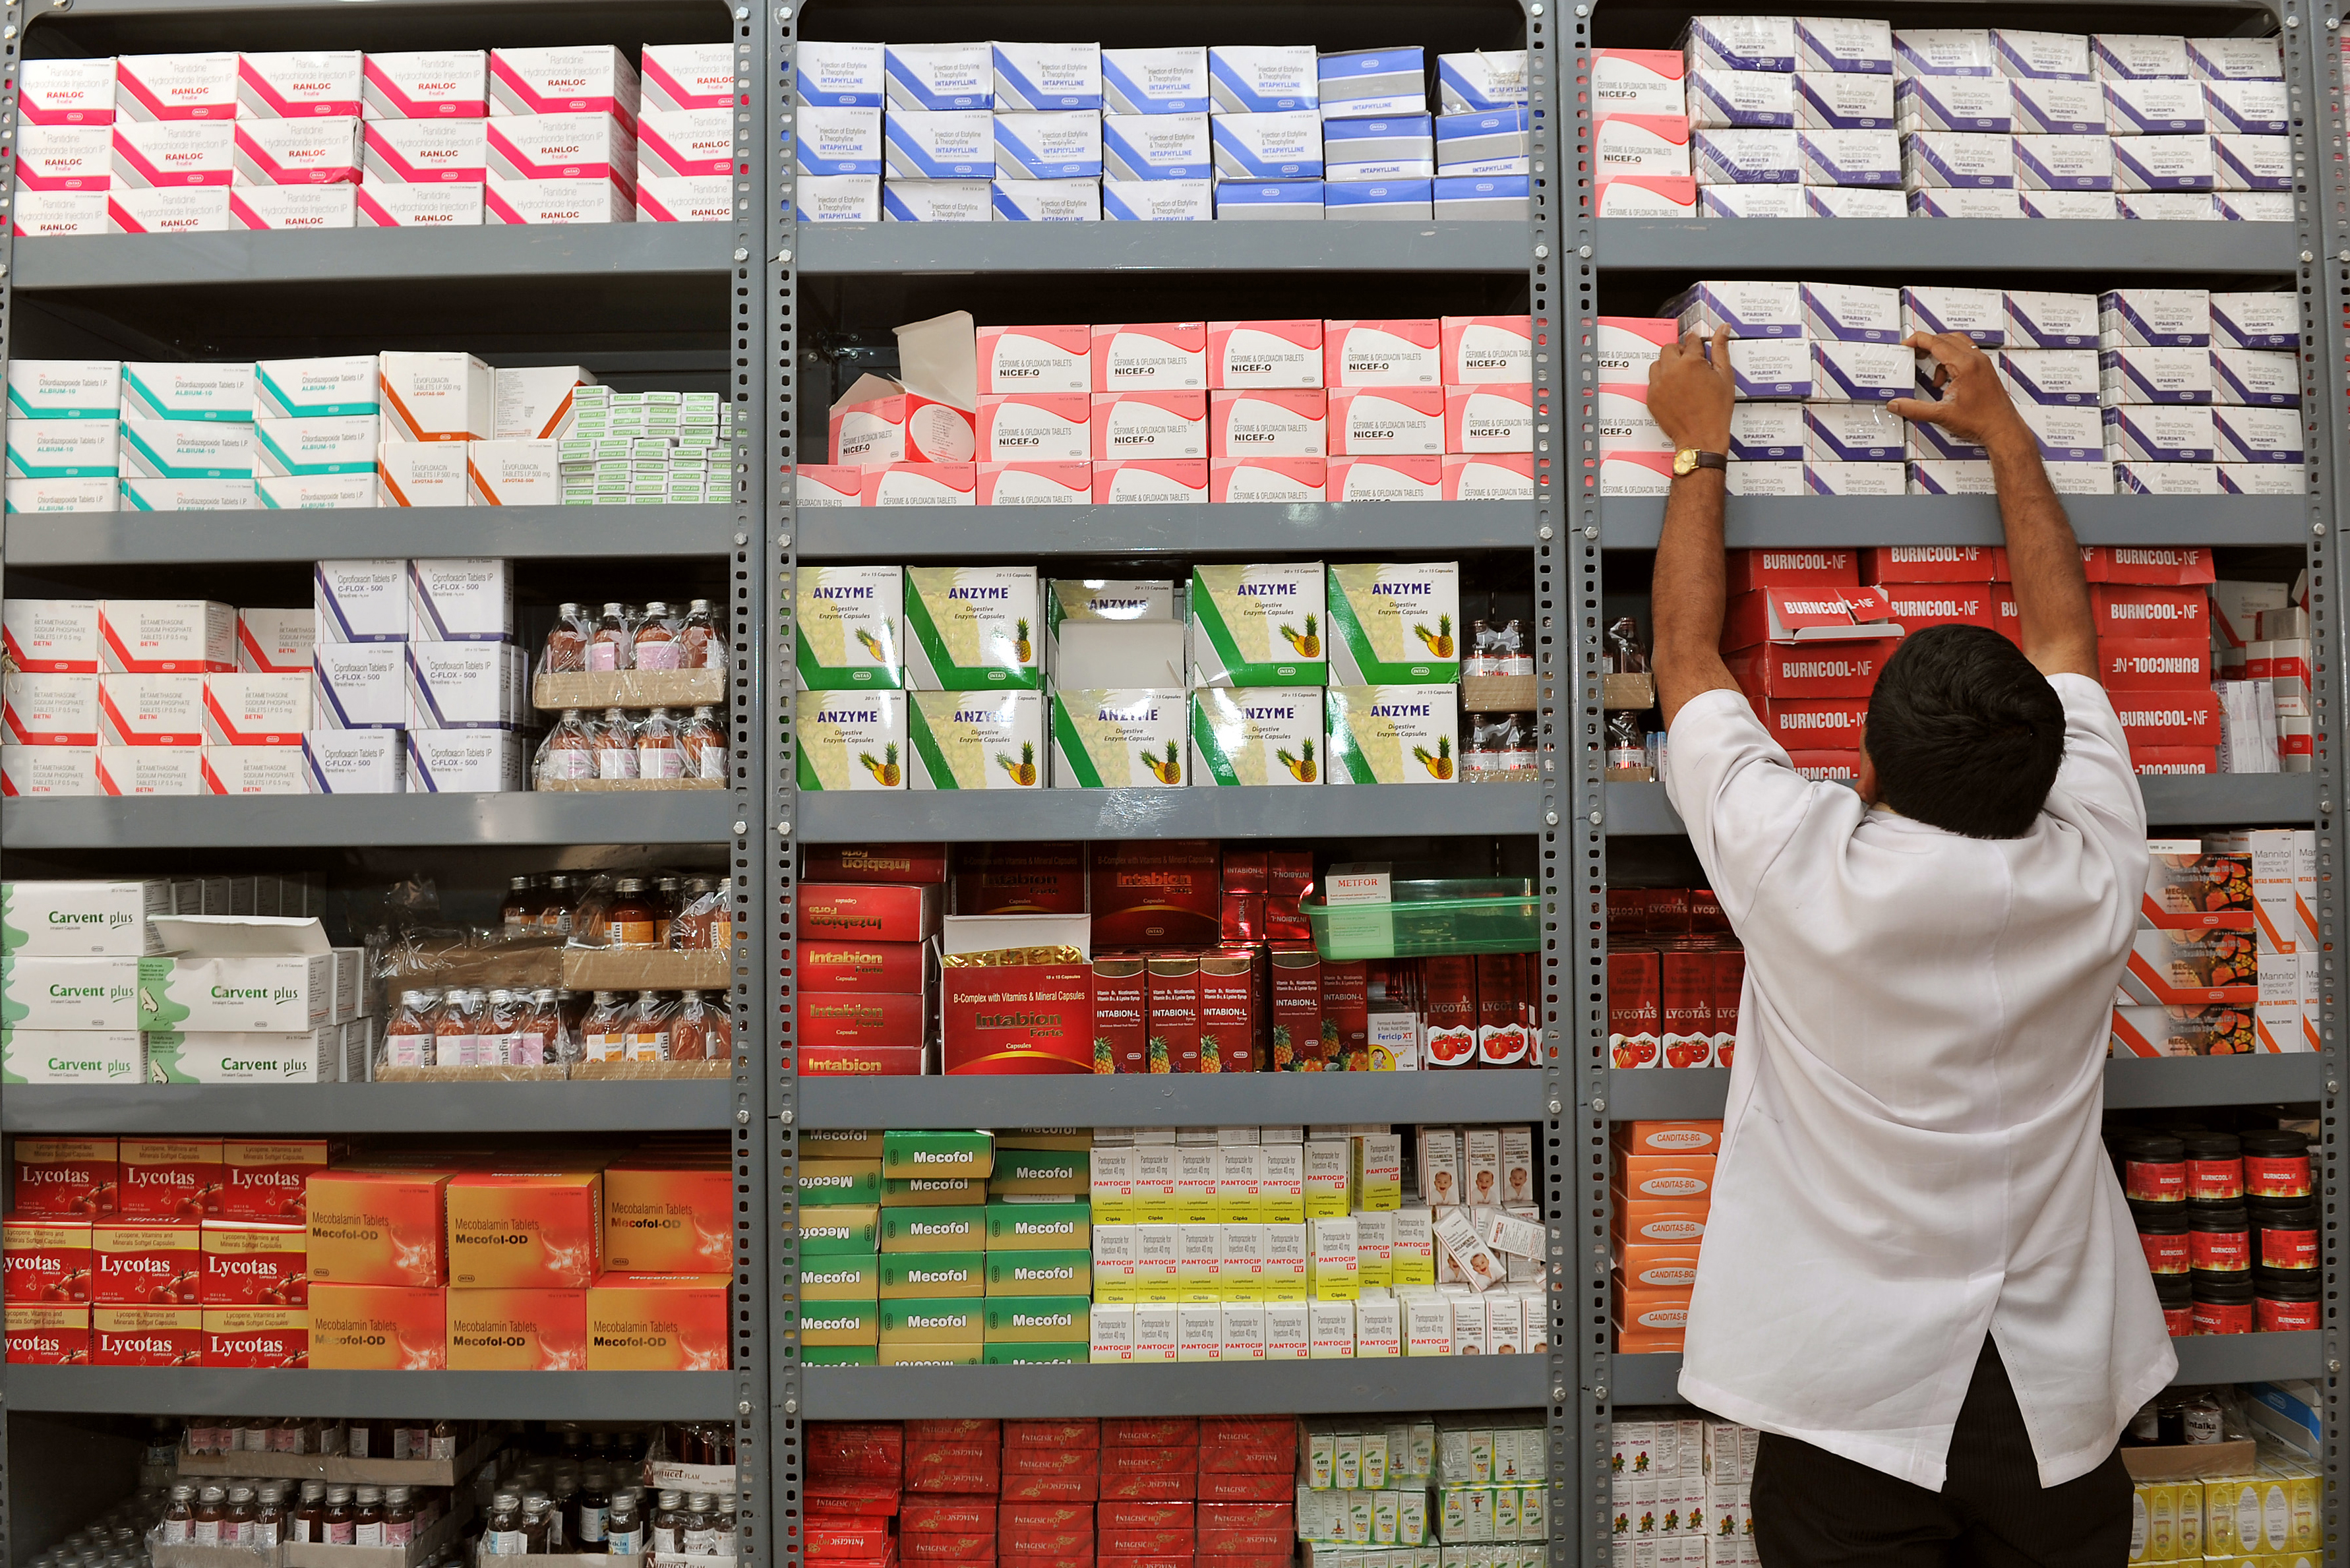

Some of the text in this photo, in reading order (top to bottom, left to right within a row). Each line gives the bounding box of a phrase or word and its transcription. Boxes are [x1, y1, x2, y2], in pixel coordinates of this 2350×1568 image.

[149, 76, 194, 87] Hydrochloride
[196, 76, 223, 84] Injection
[1624, 82, 1644, 91] OFLOXACIN
[999, 359, 1019, 367] CEFIXIME
[1027, 359, 1050, 367] OFLOXACIN
[1231, 363, 1272, 372] NICEF-O
[843, 444, 870, 454] NICEF-O
[1764, 555, 1846, 570] BURNCOOL-NF
[2116, 549, 2198, 566] BURNCOOL-NF
[338, 575, 371, 585] Ciprofloxacin
[949, 588, 1008, 599] ANZYME
[1238, 584, 1296, 596] ANZYME
[1372, 582, 1431, 595] ANZYME
[1891, 601, 1979, 617] BURNCOOL-NF
[2111, 604, 2198, 619] BURNCOOL-NF
[1783, 661, 1872, 678] BURNCOOL-NF
[2113, 657, 2199, 673] BURNCOOL-NF
[818, 710, 878, 722] ANZYME
[1371, 705, 1430, 717] ANZYME
[1338, 878, 1377, 888] METFOR
[49, 911, 133, 924] Carvent plus
[810, 917, 882, 930] Intabion
[810, 951, 882, 963] Intabion
[211, 986, 298, 1000] Carvent plus
[954, 990, 1085, 1004] B-Complex with Vitamins & Mineral Capsules
[975, 1011, 1062, 1026] Intabion
[1666, 1010, 1711, 1019] LYCOTAS
[1030, 1029, 1063, 1037] Forte
[1657, 1133, 1700, 1142] CANDITAS-BG
[914, 1151, 973, 1163] Mecofol
[1098, 1157, 1120, 1165] Pantoprazole
[22, 1166, 89, 1186] Lycotas
[1017, 1167, 1072, 1179] Mecofol
[1099, 1167, 1112, 1176] Injection
[312, 1211, 389, 1227] Mecobalamin Tablets
[312, 1228, 378, 1240] Mecofol-OD
[1015, 1222, 1073, 1234] Mecofol
[456, 1234, 528, 1245] Mecofol-OD
[101, 1255, 170, 1276] Lycotas
[801, 1272, 860, 1284] Mecofol
[2187, 1419, 2216, 1430] Intalka
